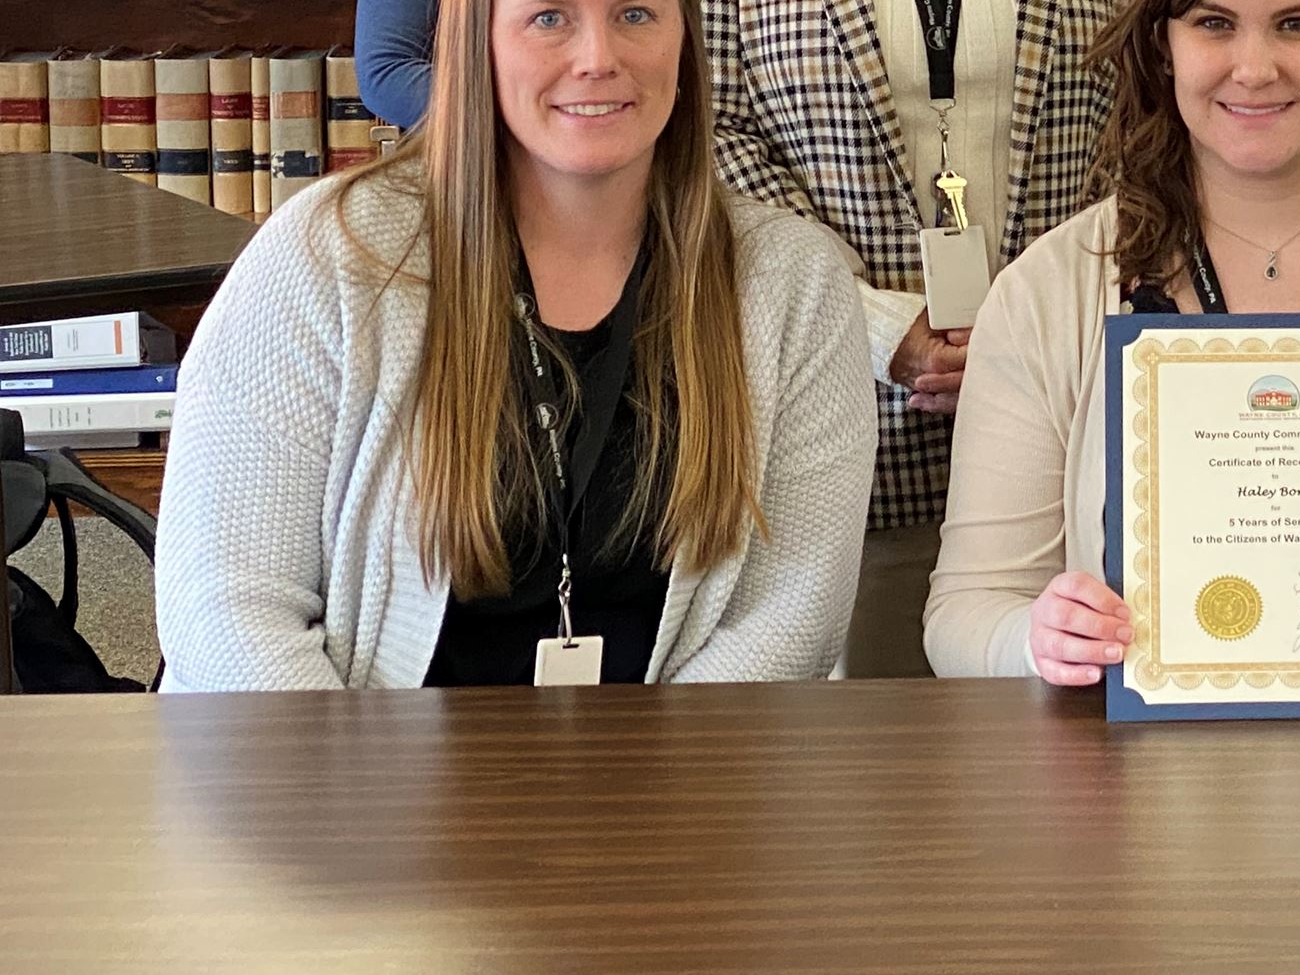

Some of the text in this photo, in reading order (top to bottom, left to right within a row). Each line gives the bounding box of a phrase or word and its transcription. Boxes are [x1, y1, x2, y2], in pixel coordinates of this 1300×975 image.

[1195, 430, 1230, 440] Wayne
[1233, 430, 1270, 440] County
[1209, 458, 1262, 467] Certificate
[1265, 458, 1276, 466] of
[1237, 486, 1276, 499] Haley
[1229, 518, 1235, 527] 5
[1238, 518, 1268, 527] Years
[1271, 517, 1282, 526] of
[1193, 536, 1203, 544] to
[1206, 535, 1223, 543] the
[1225, 534, 1268, 543] Citizens
[1270, 534, 1281, 543] of
